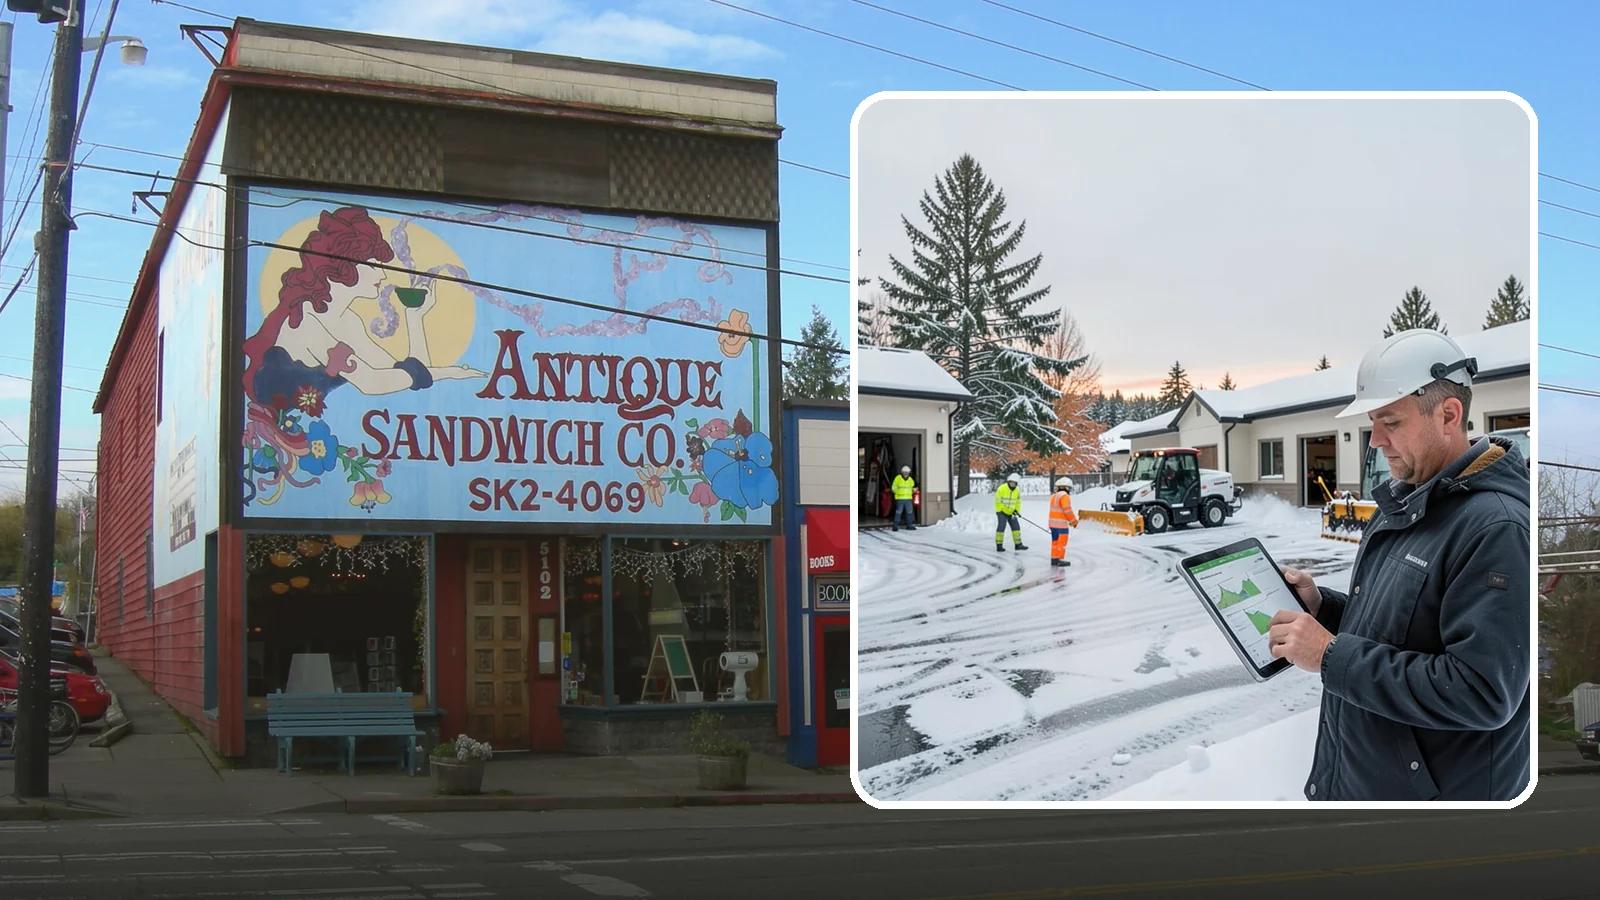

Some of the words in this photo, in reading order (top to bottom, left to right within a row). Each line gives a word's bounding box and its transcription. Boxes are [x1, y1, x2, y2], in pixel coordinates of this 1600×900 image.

[476, 329, 723, 420] ANTIQUE
[361, 409, 604, 468] SANDWICH
[618, 422, 685, 470] CO.
[468, 477, 646, 513] SK2-4069
[539, 541, 552, 600] 5102
[809, 555, 835, 570] BOOKS
